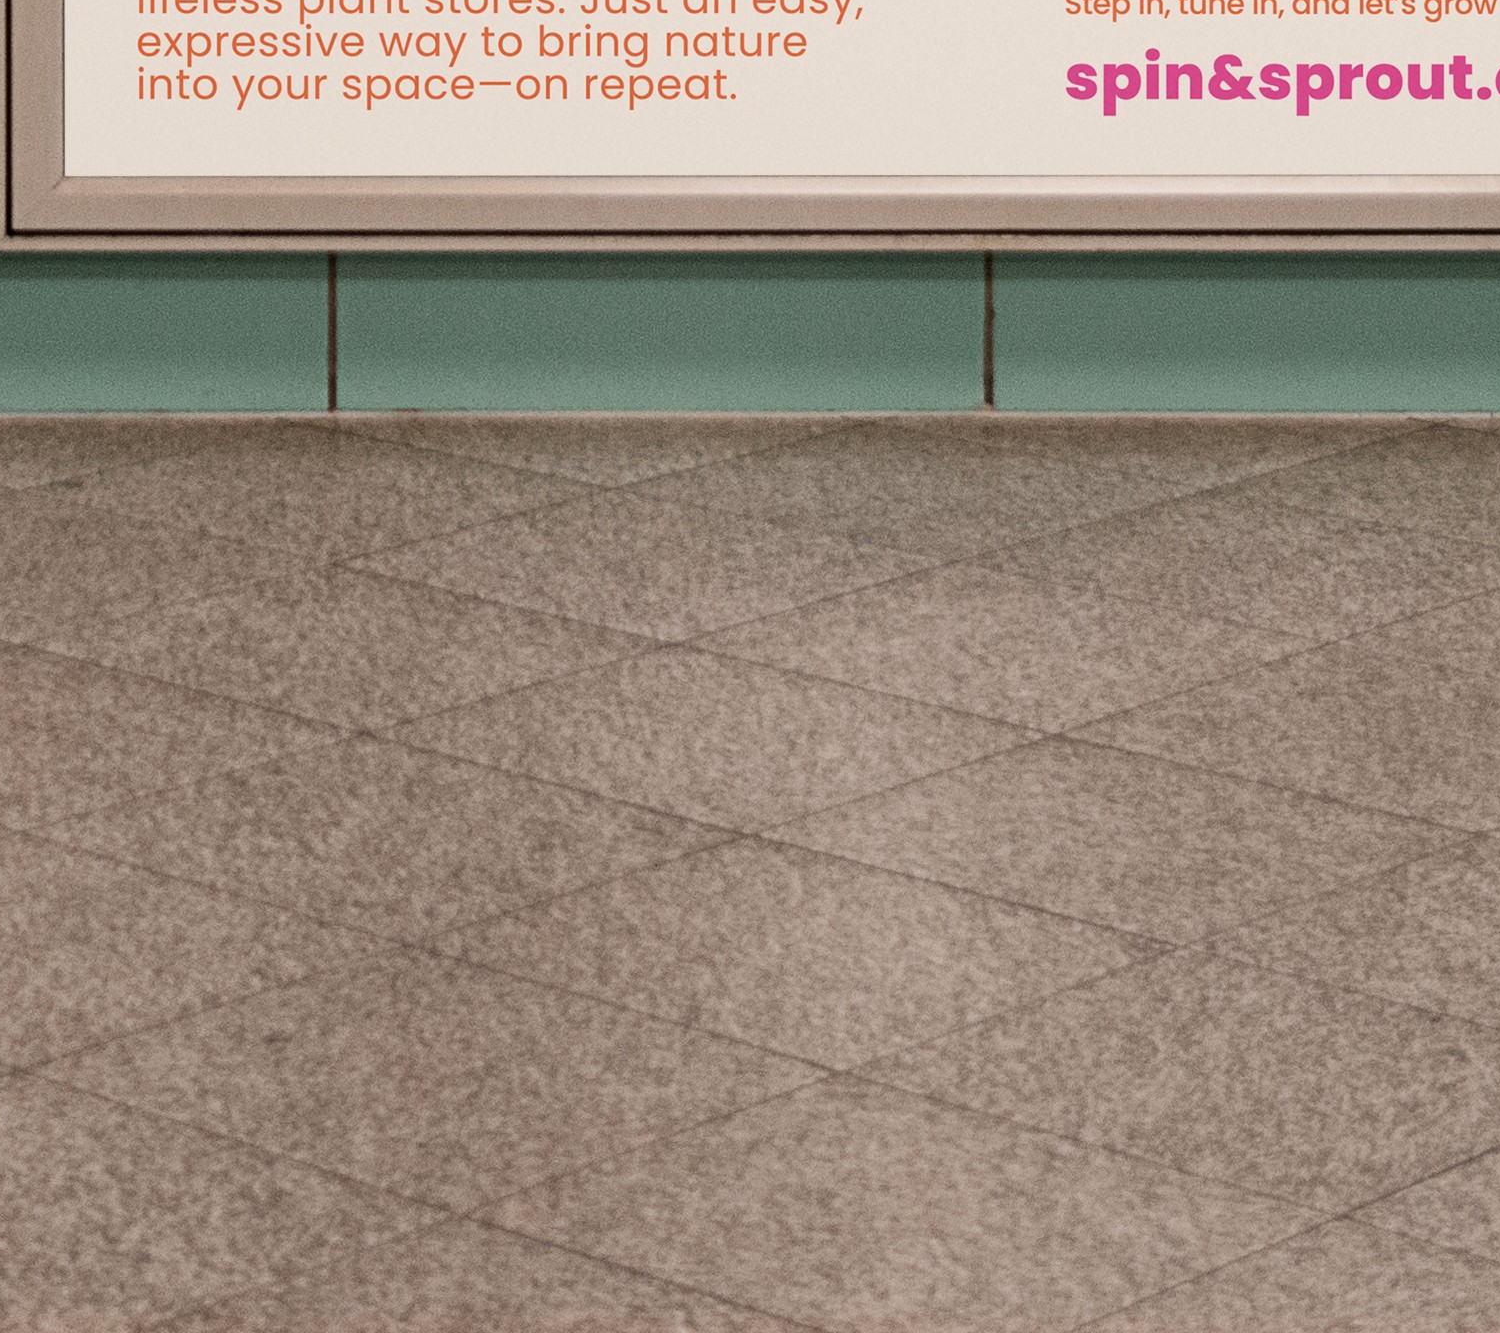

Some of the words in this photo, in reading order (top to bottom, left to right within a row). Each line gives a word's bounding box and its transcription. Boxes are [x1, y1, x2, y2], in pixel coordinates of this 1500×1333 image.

[137, 24, 365, 67] expressive
[379, 31, 467, 68] way
[481, 26, 523, 58] to
[539, 24, 649, 68] bring
[666, 26, 807, 58] nature
[138, 66, 218, 100] into
[232, 74, 328, 111] your
[585, 69, 737, 111] repeat.
